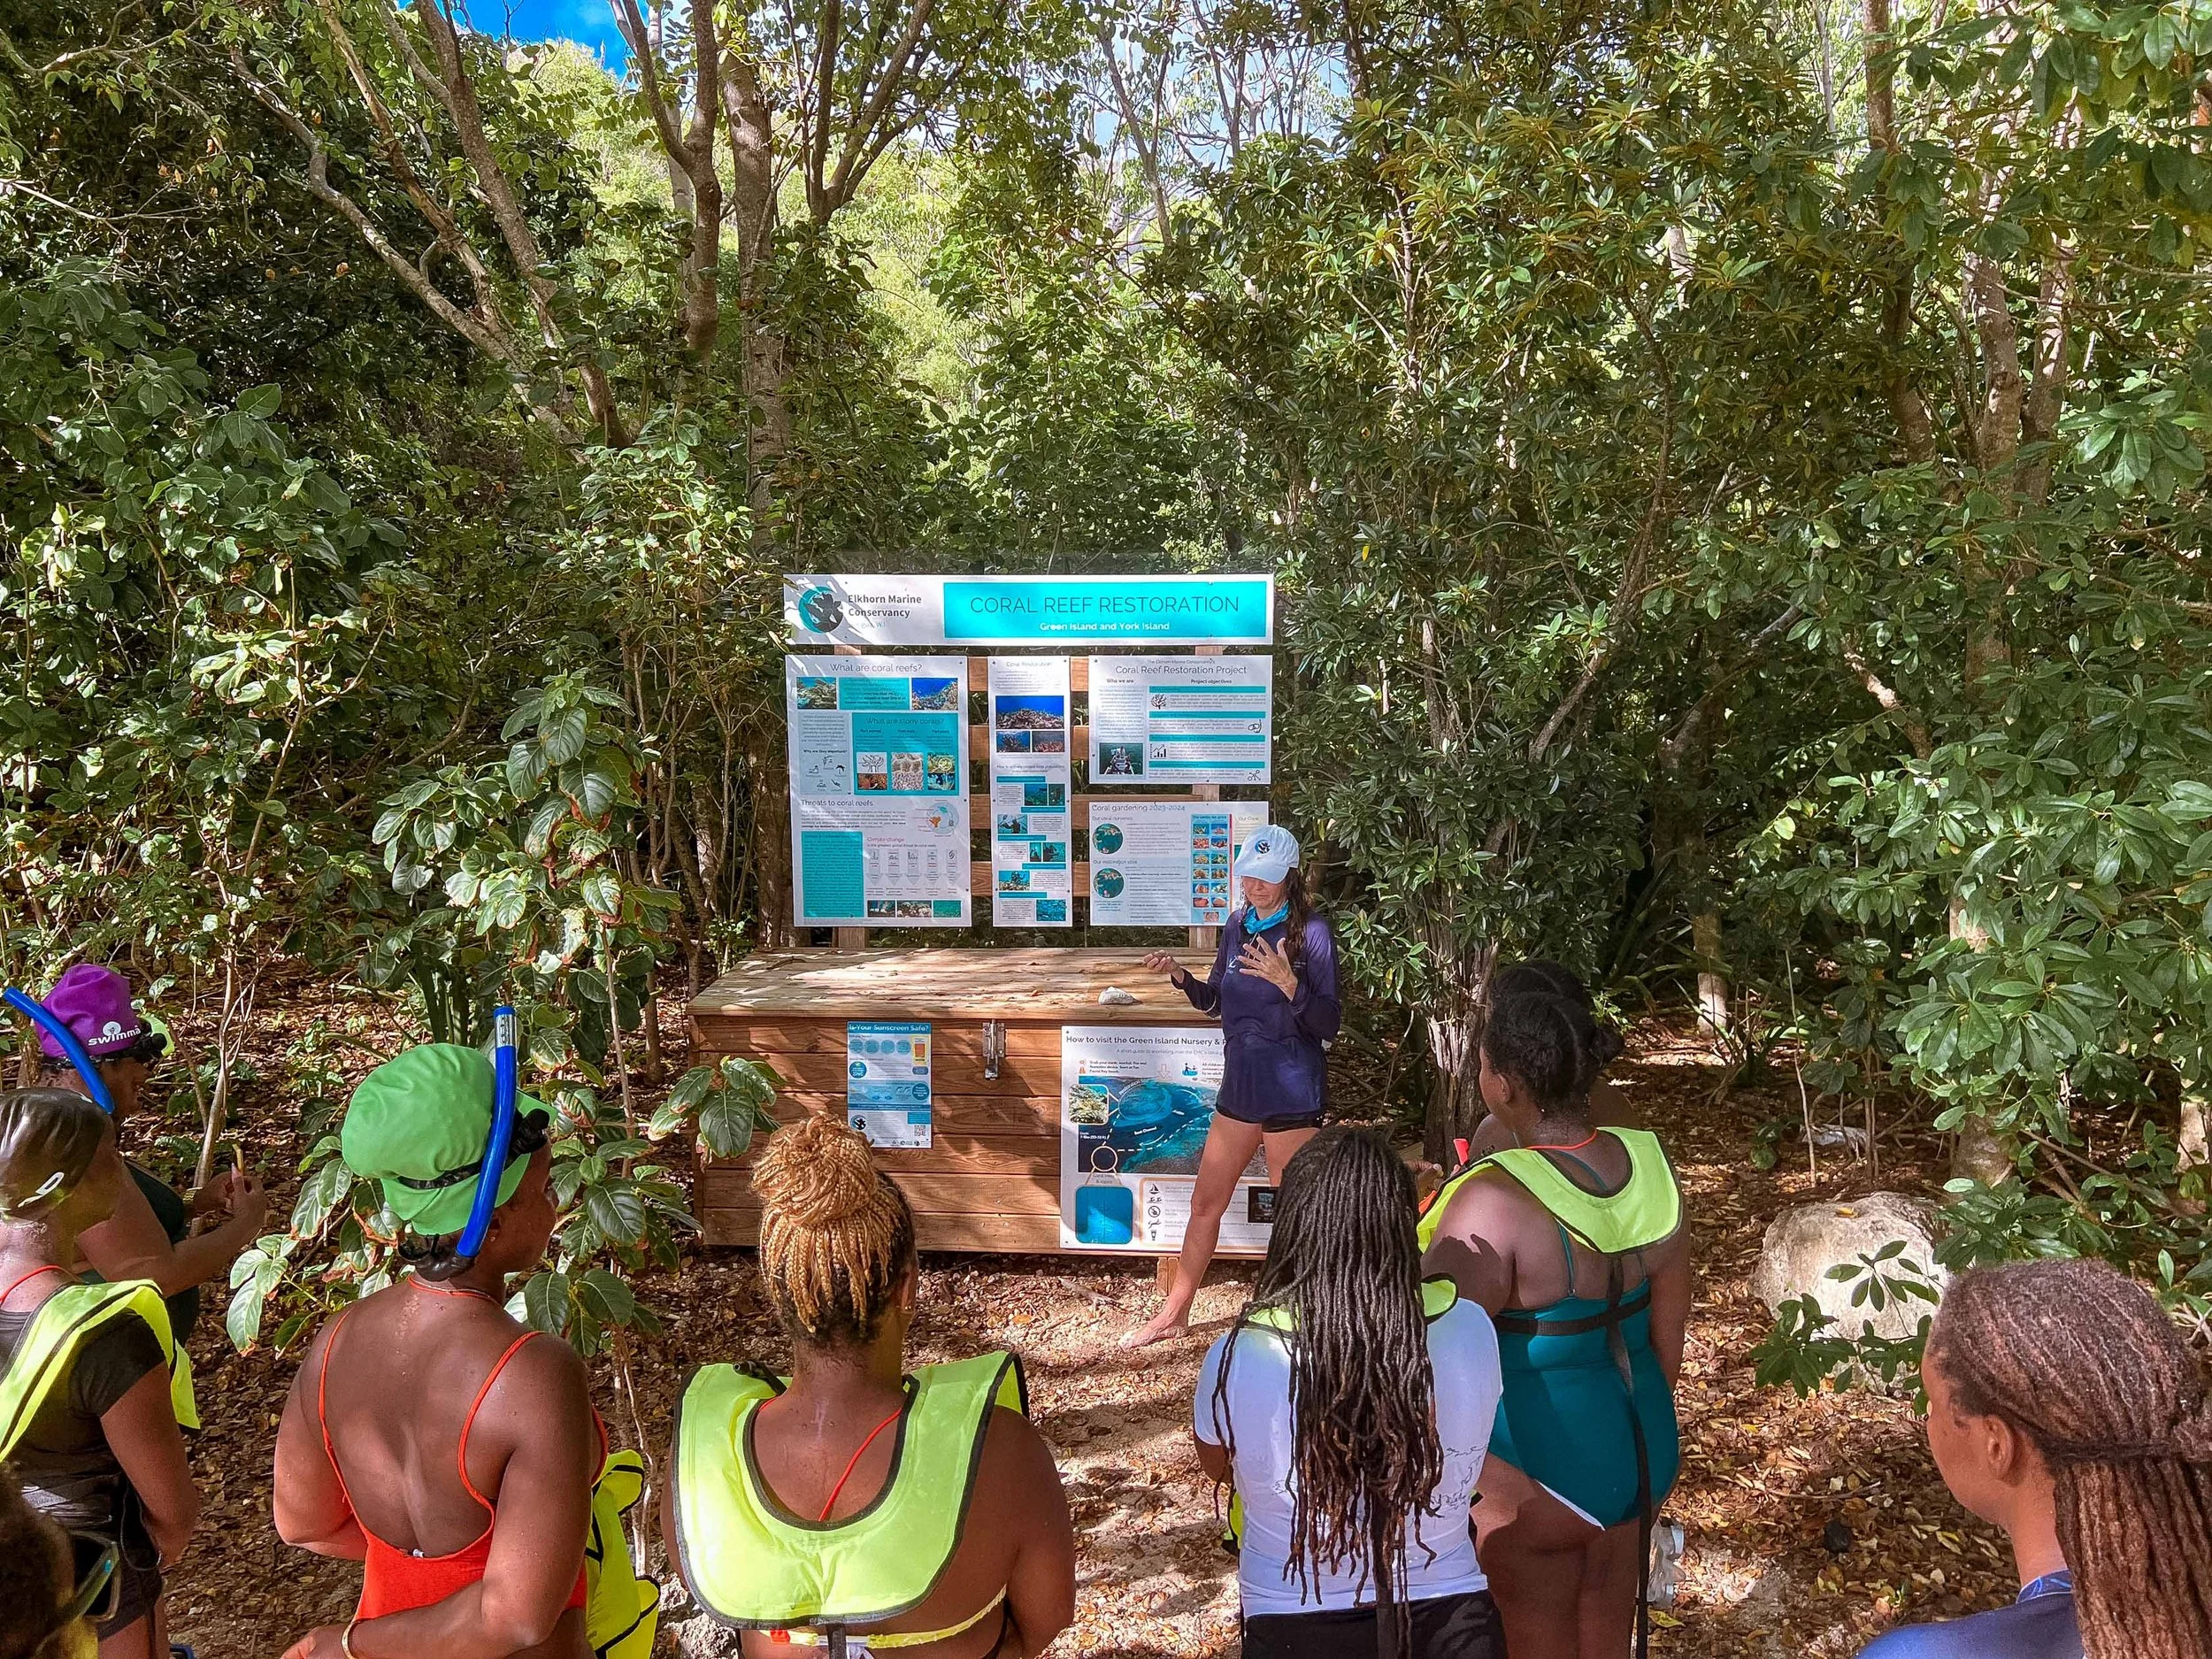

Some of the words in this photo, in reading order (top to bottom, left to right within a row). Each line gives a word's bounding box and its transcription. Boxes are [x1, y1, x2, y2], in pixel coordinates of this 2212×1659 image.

[848, 595, 886, 603] Elkhorn
[888, 595, 922, 603] Marine
[970, 597, 1038, 613] CORAL
[1044, 597, 1093, 613] REEF
[1099, 596, 1239, 613] RESTORATION
[849, 608, 910, 618] Conservancy
[1040, 622, 1067, 631] Green
[1069, 622, 1097, 630] Island
[1119, 622, 1140, 630] York
[1142, 622, 1170, 630] Island
[830, 663, 853, 672] What
[872, 663, 893, 672] coral
[895, 664, 922, 672] reefs?
[1116, 666, 1139, 674] Coral
[1141, 666, 1161, 674] Reef
[1164, 666, 1214, 674] Restoration
[1216, 666, 1247, 676] Project
[1181, 1038, 1213, 1046] Nursery
